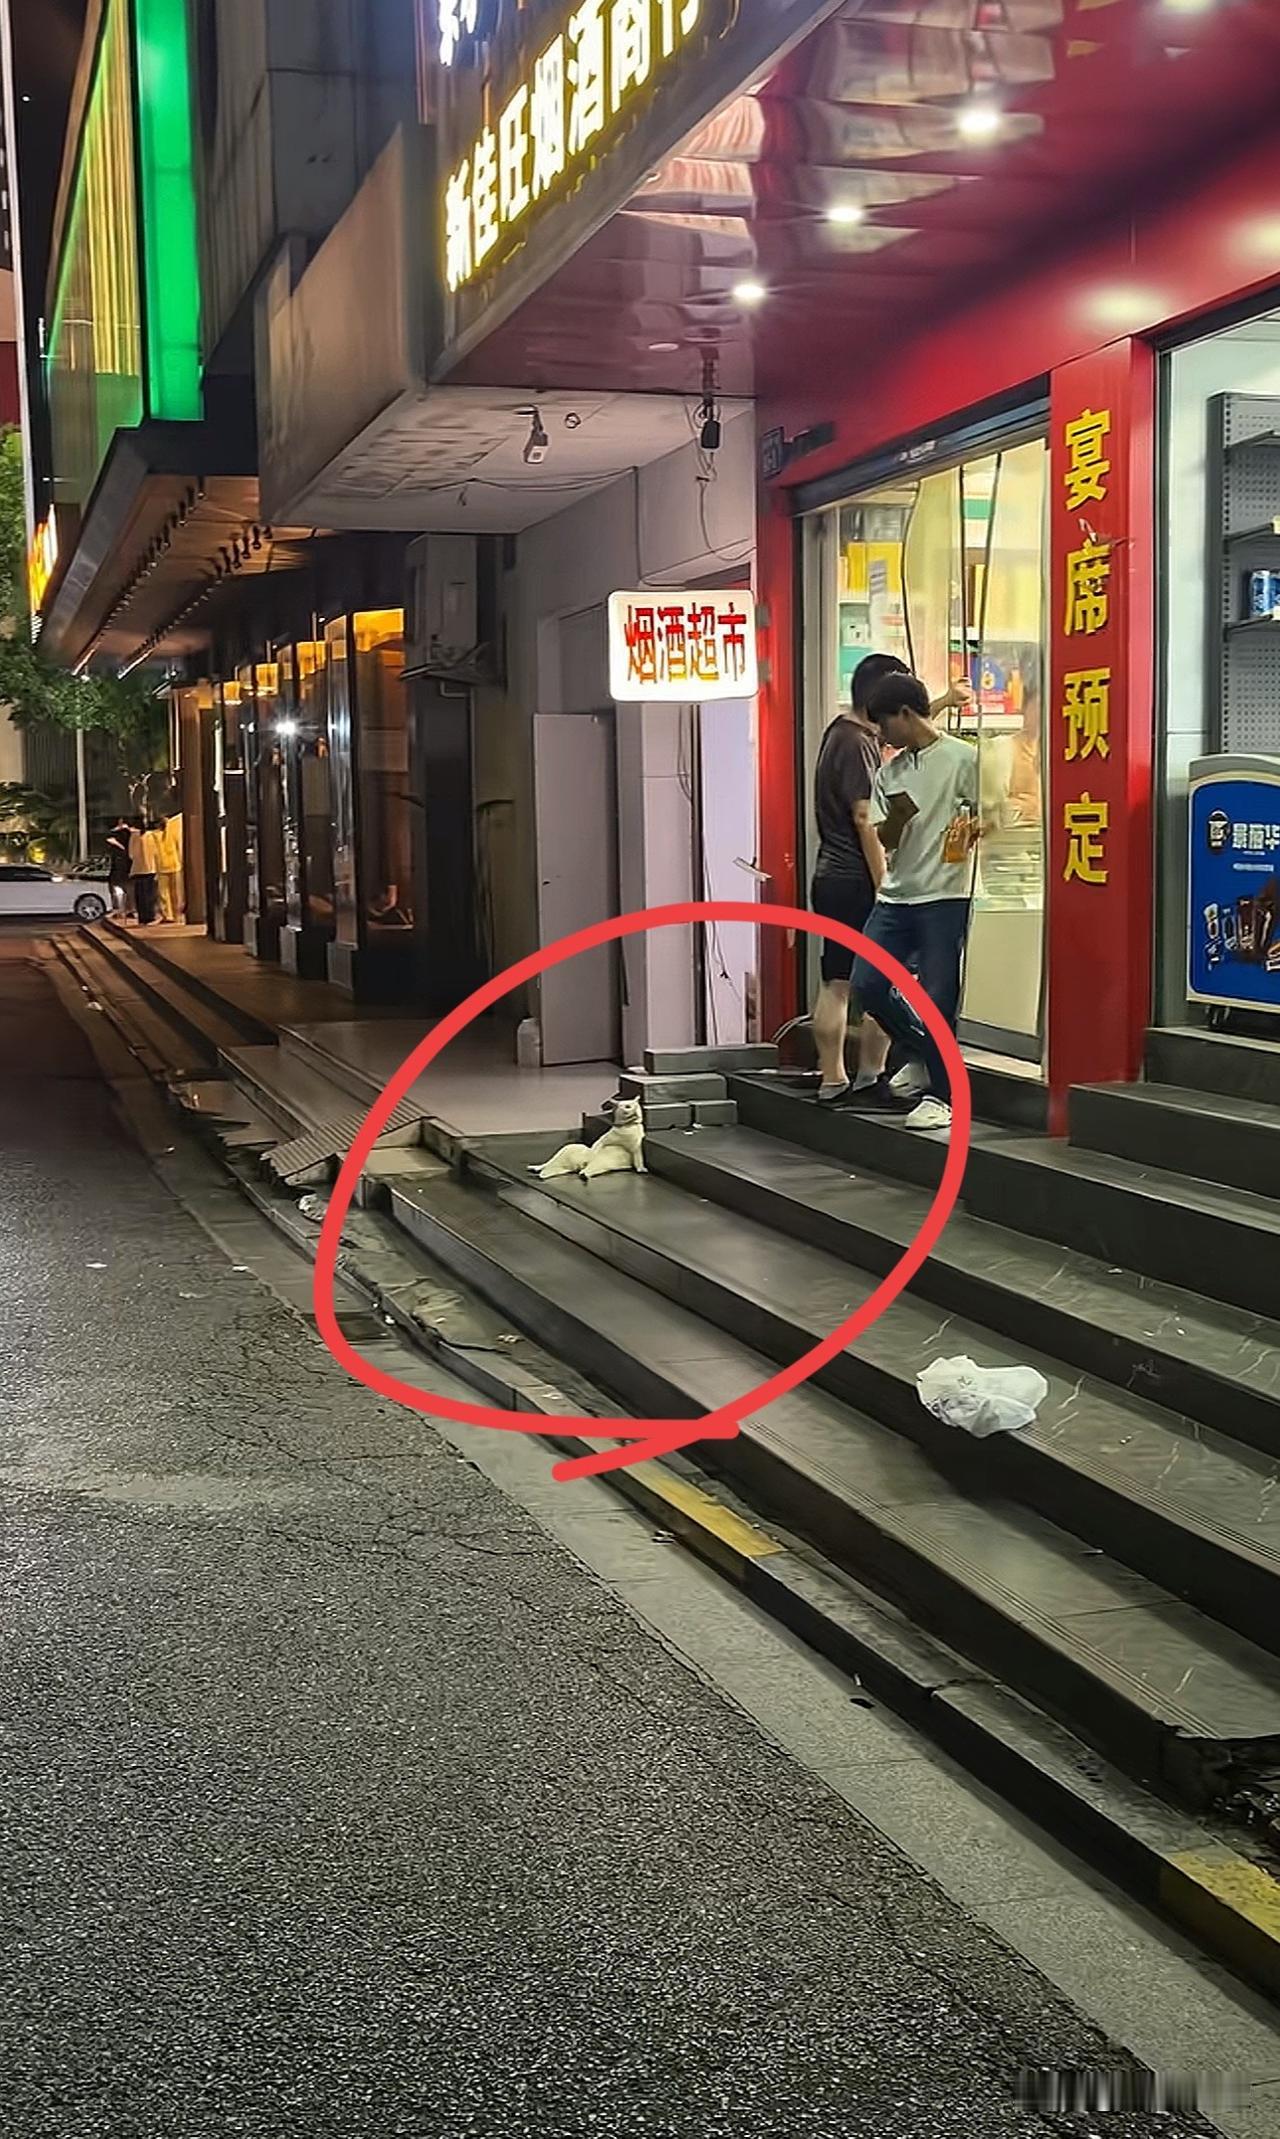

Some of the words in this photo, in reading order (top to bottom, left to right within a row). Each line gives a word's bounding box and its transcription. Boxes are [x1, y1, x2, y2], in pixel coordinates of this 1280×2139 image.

[624, 602, 747, 684] 烟酒超市
[1063, 408, 1110, 884] 宴席预定
